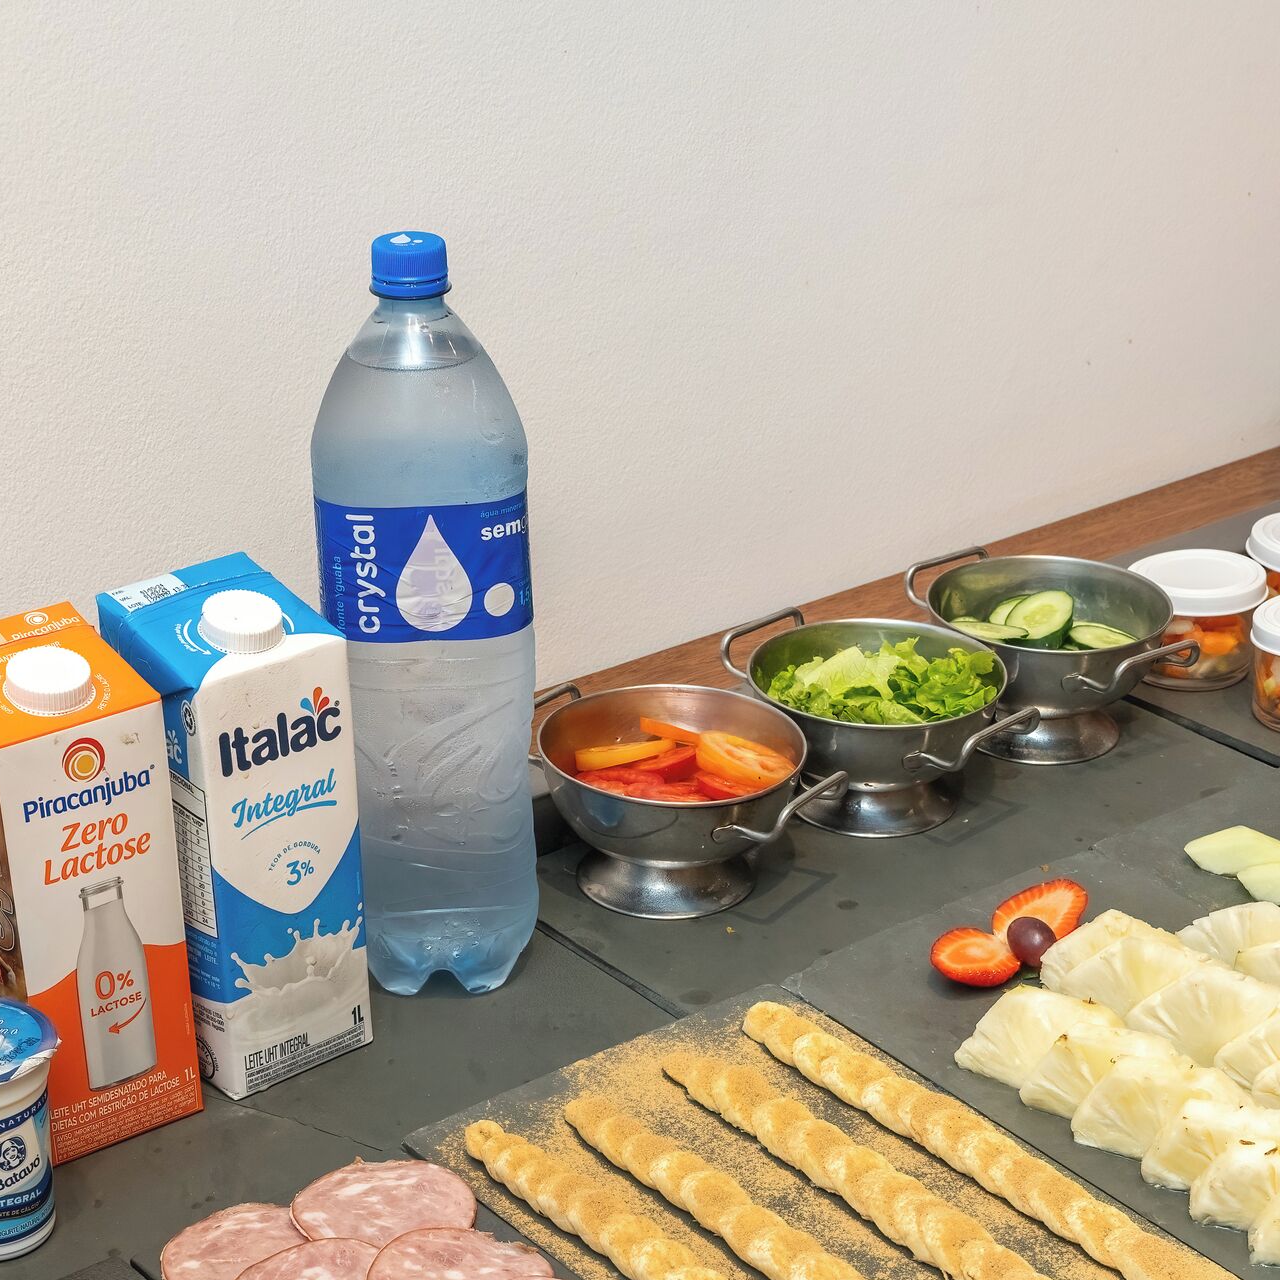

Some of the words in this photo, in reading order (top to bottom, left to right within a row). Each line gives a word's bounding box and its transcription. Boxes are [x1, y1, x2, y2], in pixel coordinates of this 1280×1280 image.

[480, 519, 521, 541] sem
[345, 514, 386, 634] crystal
[0, 652, 16, 665] ANT
[218, 706, 342, 778] Italac
[23, 769, 151, 823] Piracanjuba
[231, 768, 337, 828] Integral
[61, 813, 129, 852] Zero
[44, 832, 151, 886] Lactose
[286, 859, 314, 886] 3%
[94, 969, 135, 1000] 0%
[90, 991, 143, 1018] LACTOSE
[351, 1004, 364, 1025] 1L
[244, 1050, 263, 1071] LEITE
[264, 1044, 278, 1064] UHT
[279, 1032, 311, 1058] INTEGRAL
[49, 1106, 71, 1120] LEITE
[70, 1101, 88, 1114] UHT
[88, 1079, 147, 1108] SEMIDESNATADO
[148, 1070, 167, 1086] PARA
[52, 1117, 78, 1132] DIETAS
[78, 1109, 98, 1124] COM
[150, 1076, 180, 1100] LACTOSE
